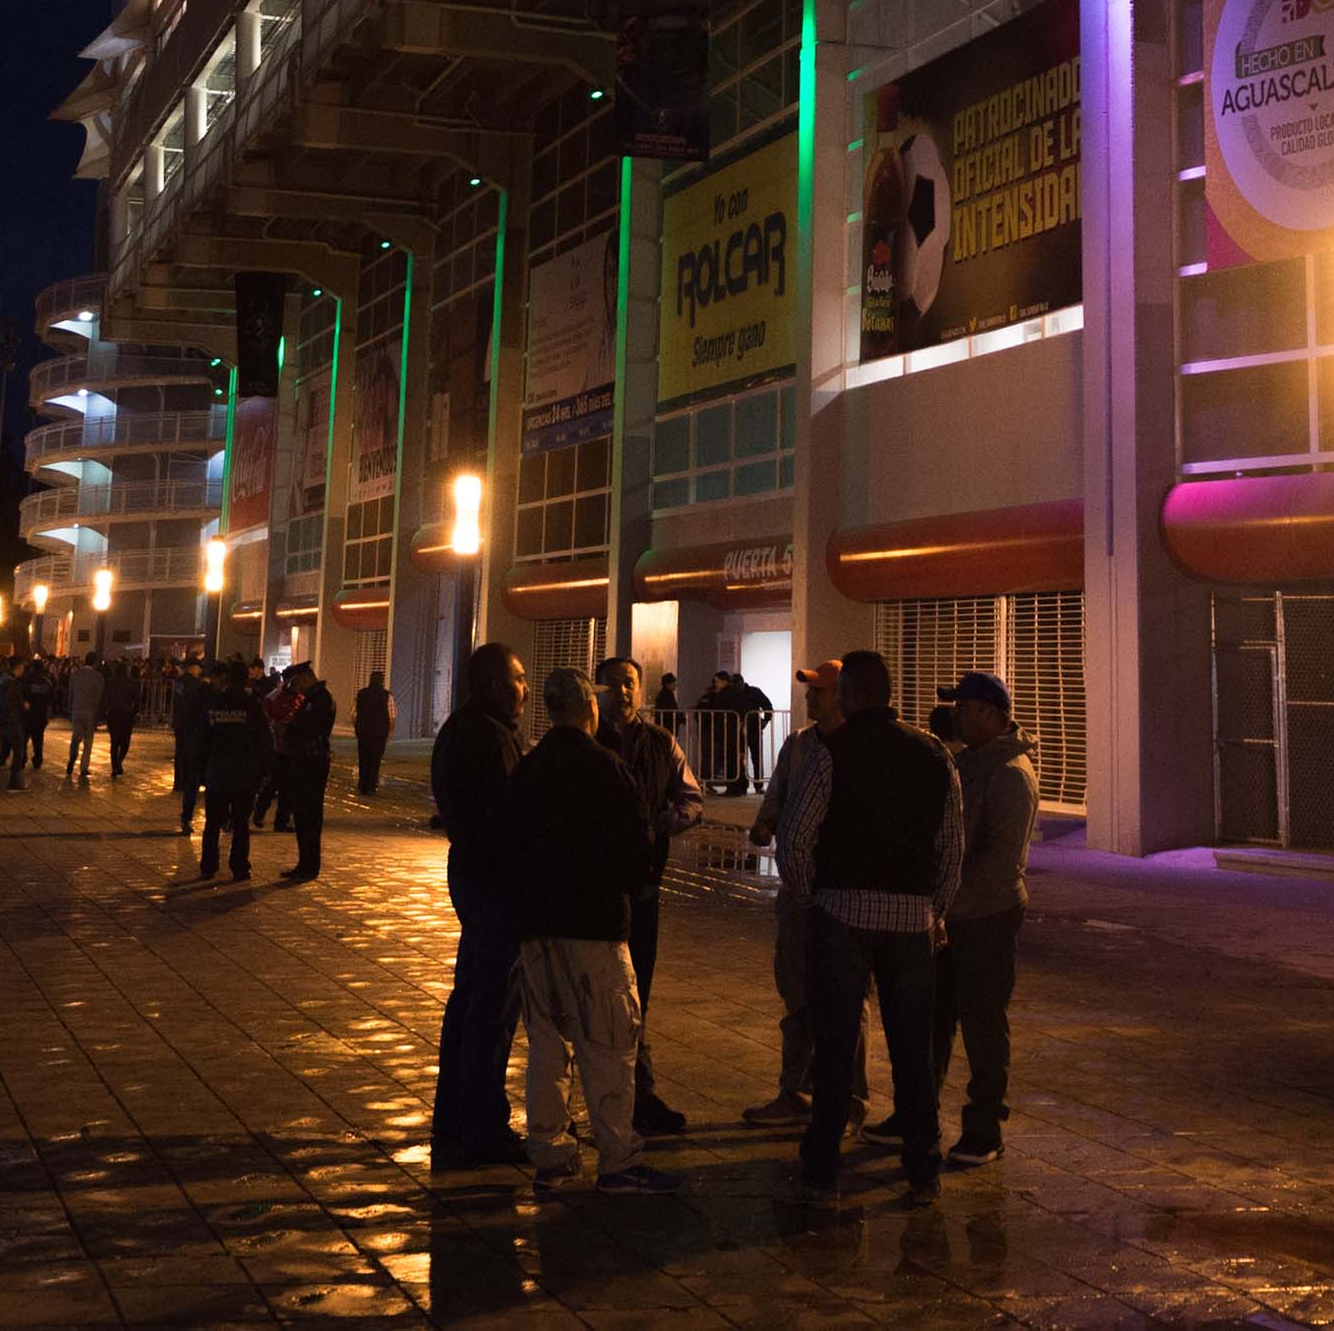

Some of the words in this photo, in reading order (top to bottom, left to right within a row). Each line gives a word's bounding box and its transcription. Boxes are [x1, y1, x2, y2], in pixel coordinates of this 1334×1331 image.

[1241, 47, 1292, 74] HECHO
[1294, 42, 1316, 62] EN
[1270, 118, 1314, 142] PRODUCTO
[1281, 135, 1317, 156] CALIDAD
[954, 131, 1026, 203] OFICIAL
[1030, 119, 1054, 169] DE
[728, 188, 749, 220] con
[954, 161, 1081, 264] INTENSIDA
[677, 212, 787, 329] ROLCAR
[724, 545, 778, 580] PUERTA
